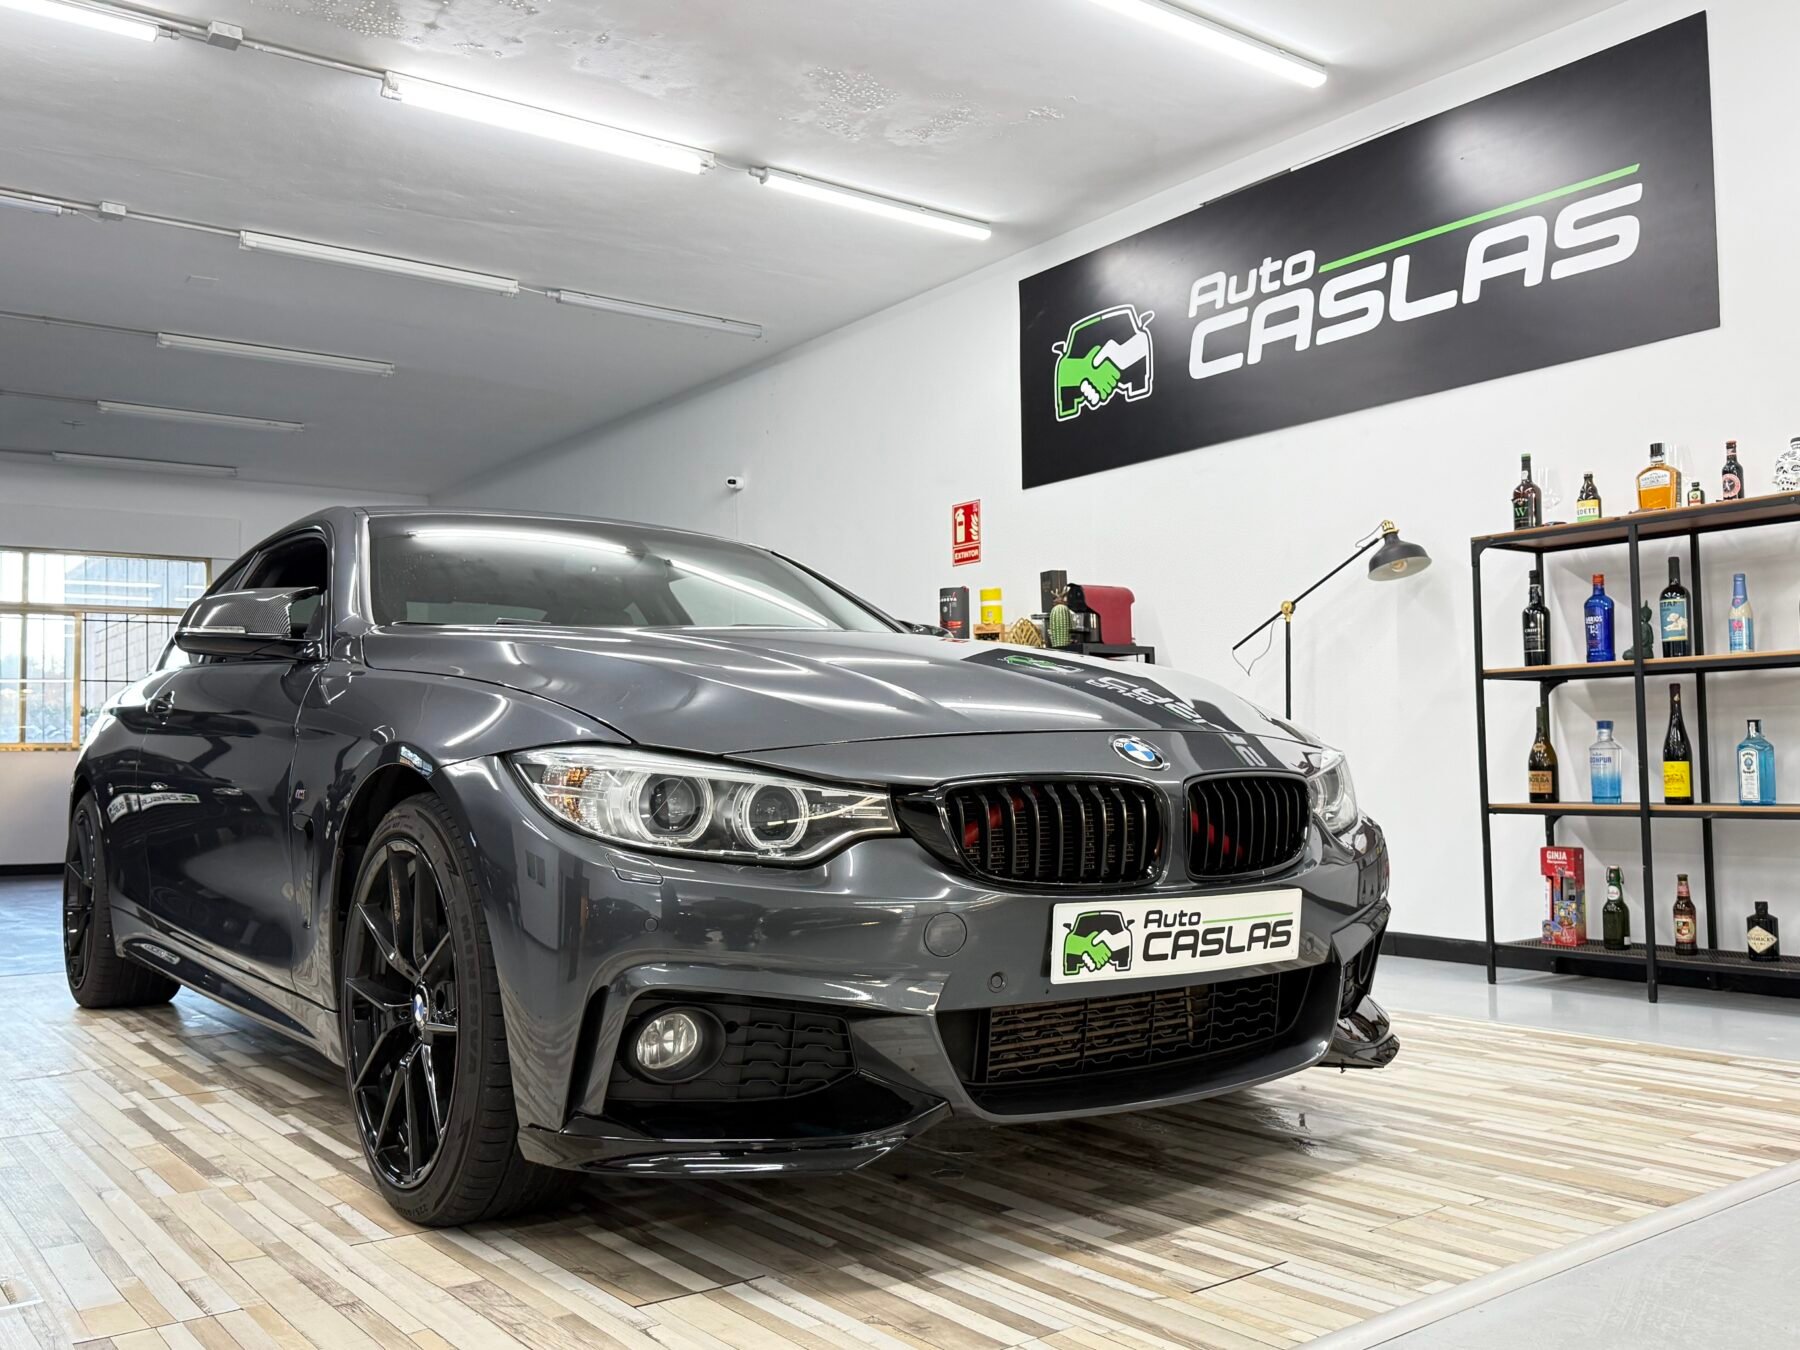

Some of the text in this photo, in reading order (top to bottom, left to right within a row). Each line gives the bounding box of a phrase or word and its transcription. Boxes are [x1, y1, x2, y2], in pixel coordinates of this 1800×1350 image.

[1188, 183, 1643, 380] CASLAS
[1188, 249, 1317, 318] Auto
[954, 548, 979, 560] EXTINTOR
[1546, 850, 1568, 861] GINJA
[1143, 909, 1201, 928] Auto
[1143, 919, 1293, 961] CASLAS
